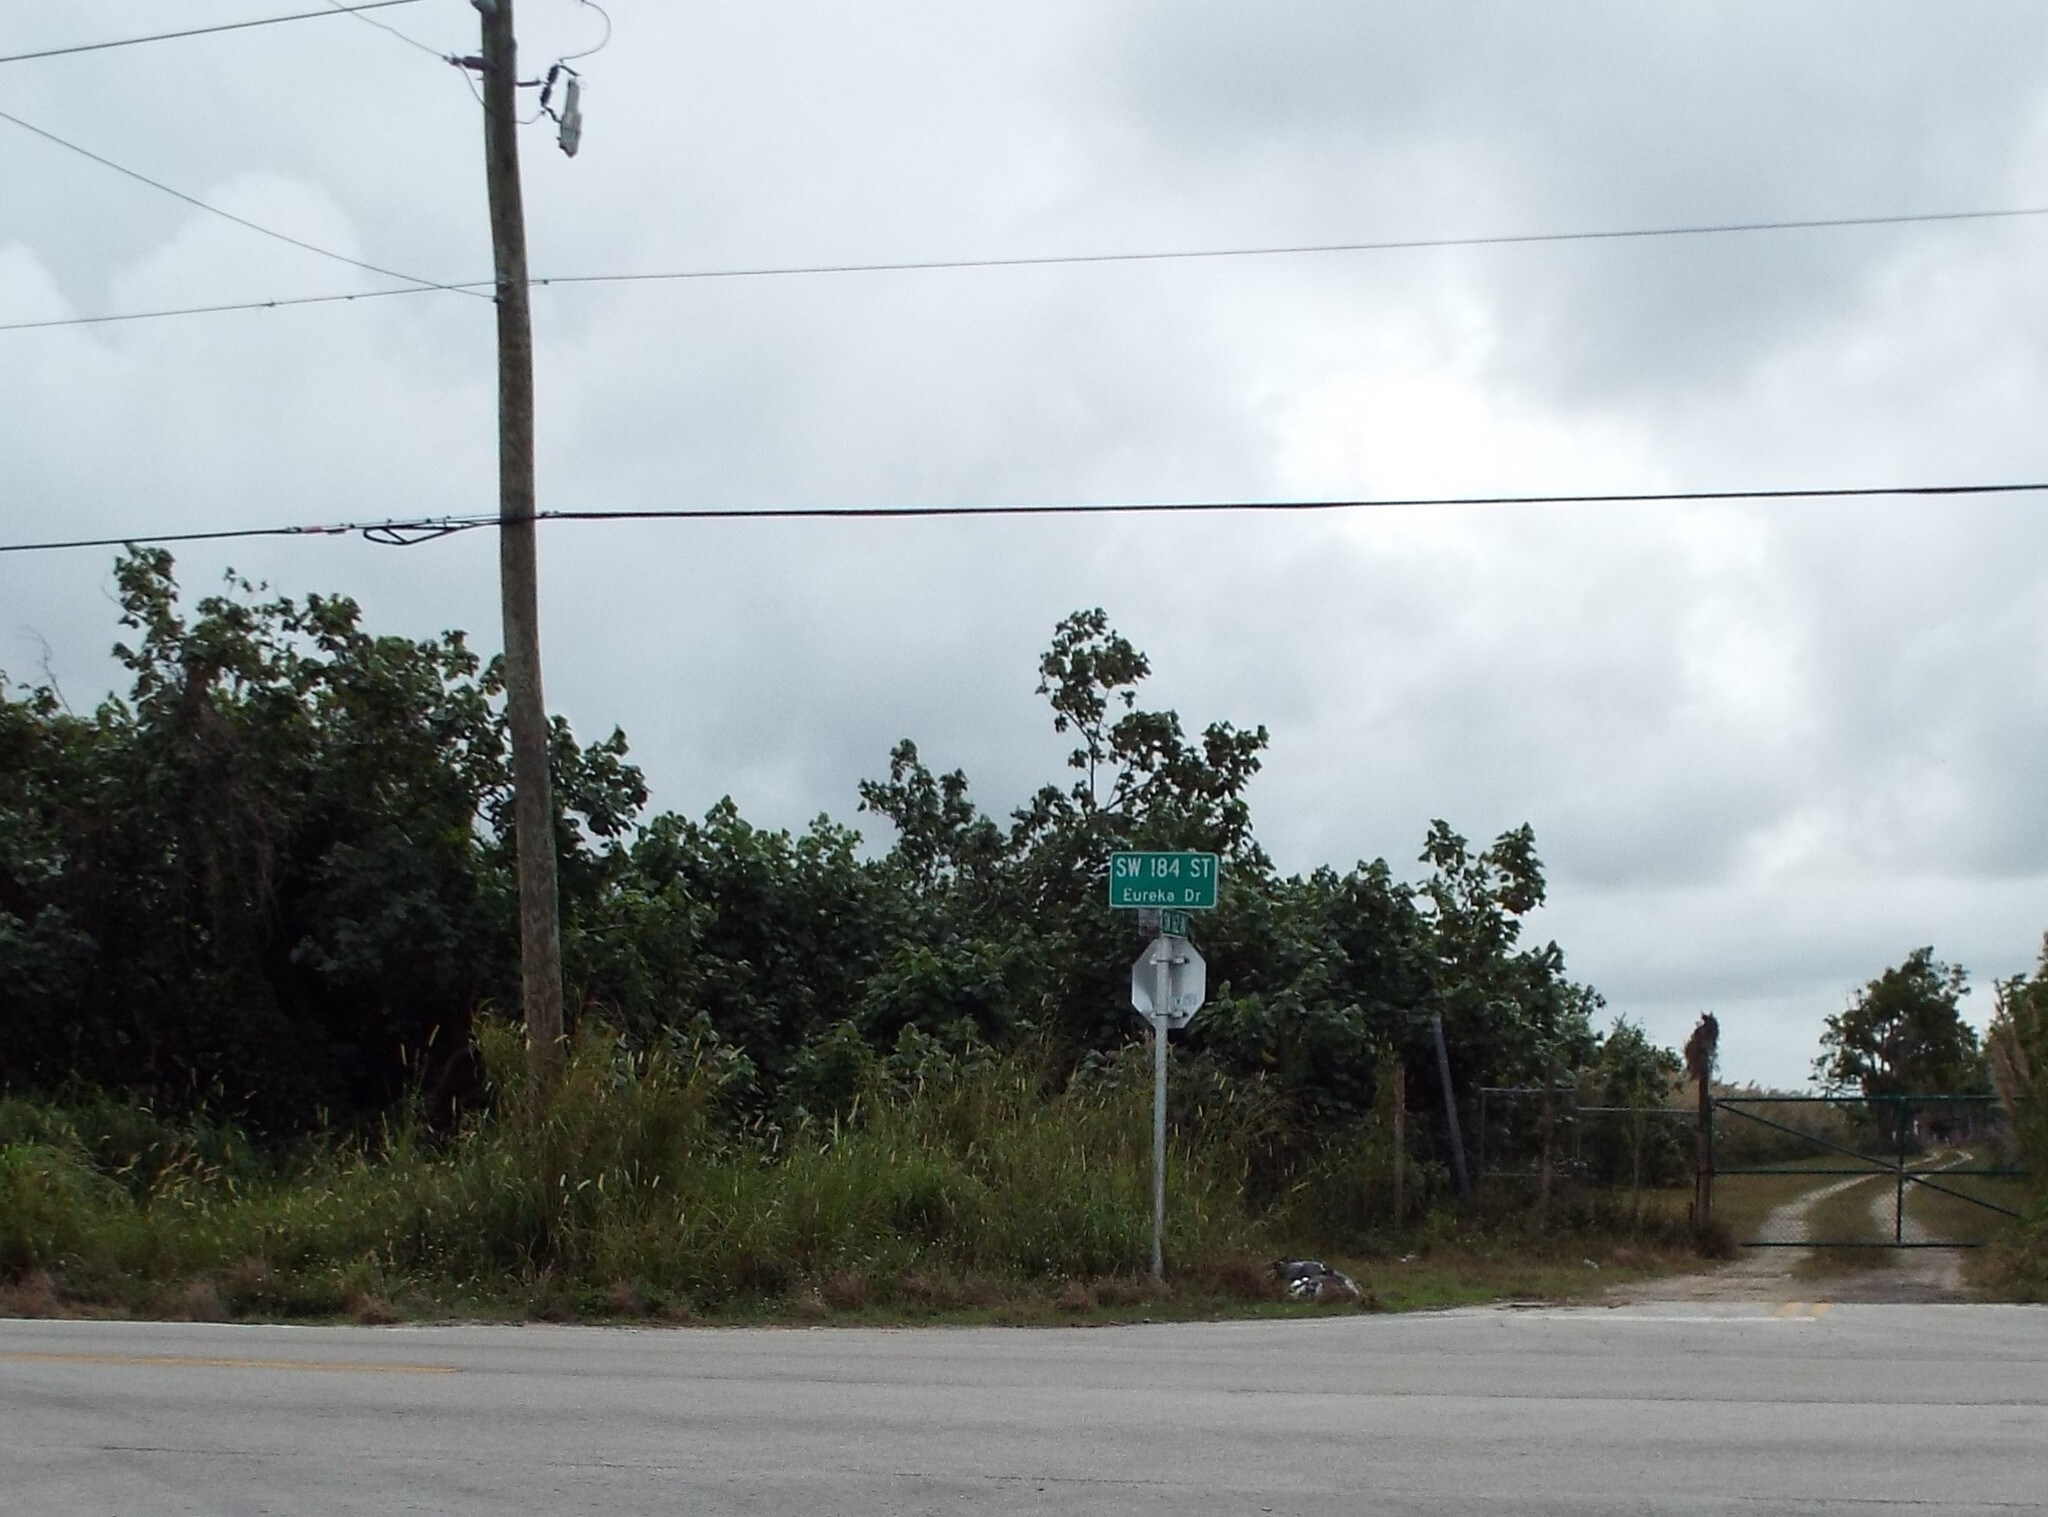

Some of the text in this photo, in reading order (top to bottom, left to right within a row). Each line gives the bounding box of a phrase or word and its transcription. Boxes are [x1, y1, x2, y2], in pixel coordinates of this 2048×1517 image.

[1116, 857, 1211, 878] SW 184 ST
[1123, 888, 1202, 902] Eureka Dr
